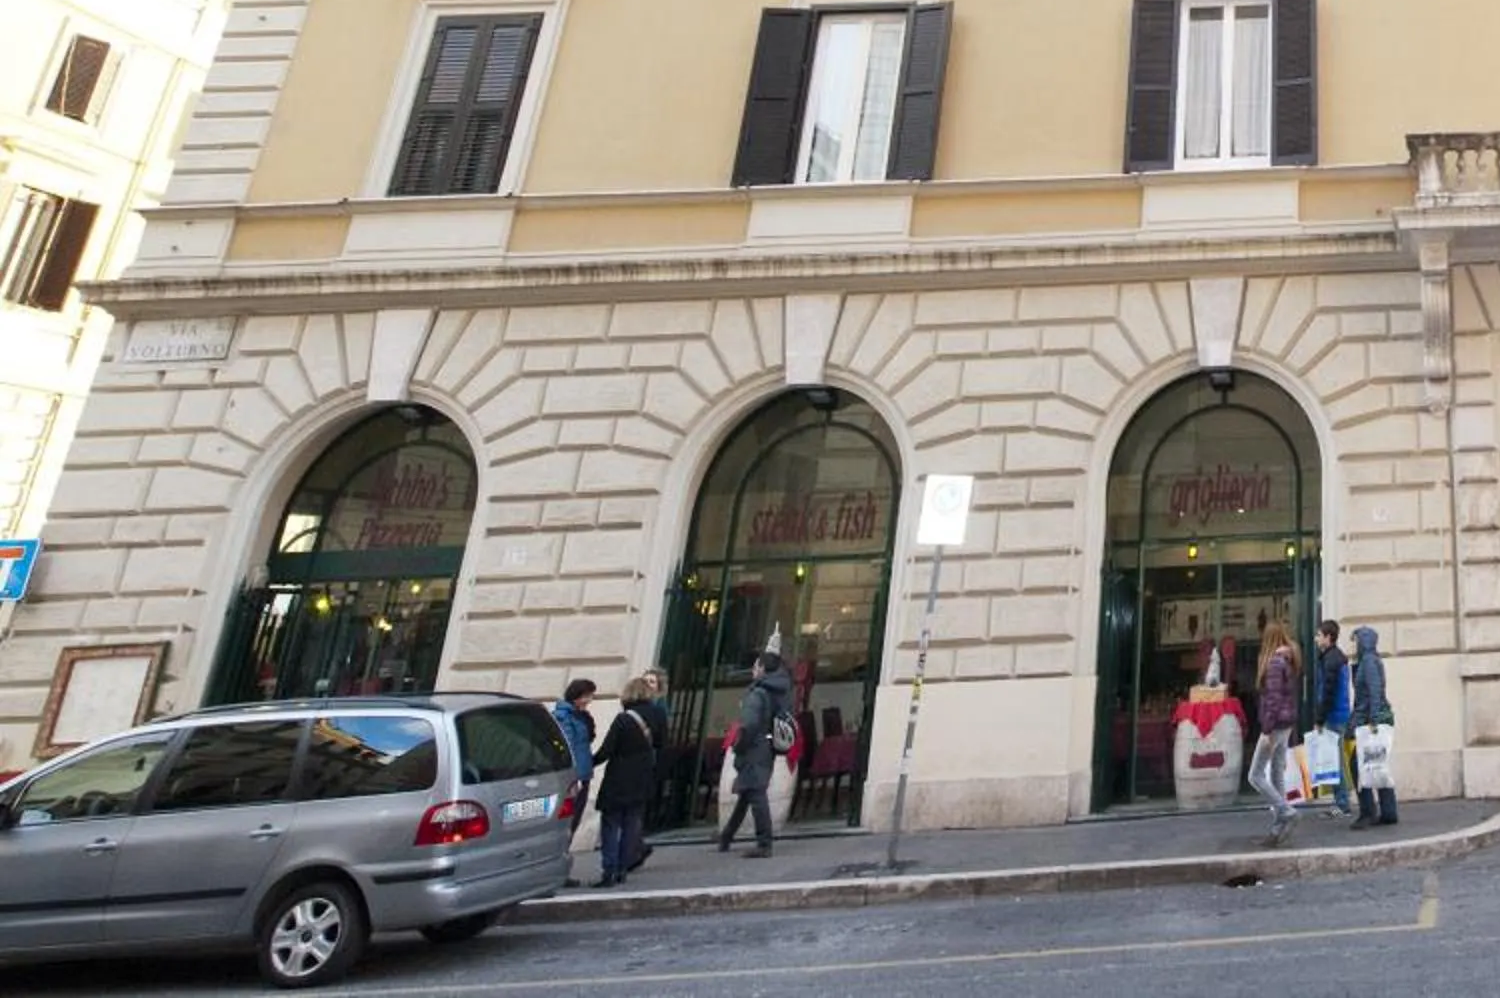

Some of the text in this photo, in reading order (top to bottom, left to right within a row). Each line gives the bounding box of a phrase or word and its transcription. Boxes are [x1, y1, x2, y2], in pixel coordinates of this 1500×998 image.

[169, 322, 198, 336] VIA
[130, 343, 226, 358] VOLTURNO
[748, 491, 812, 544] steak
[833, 490, 877, 540] fish
